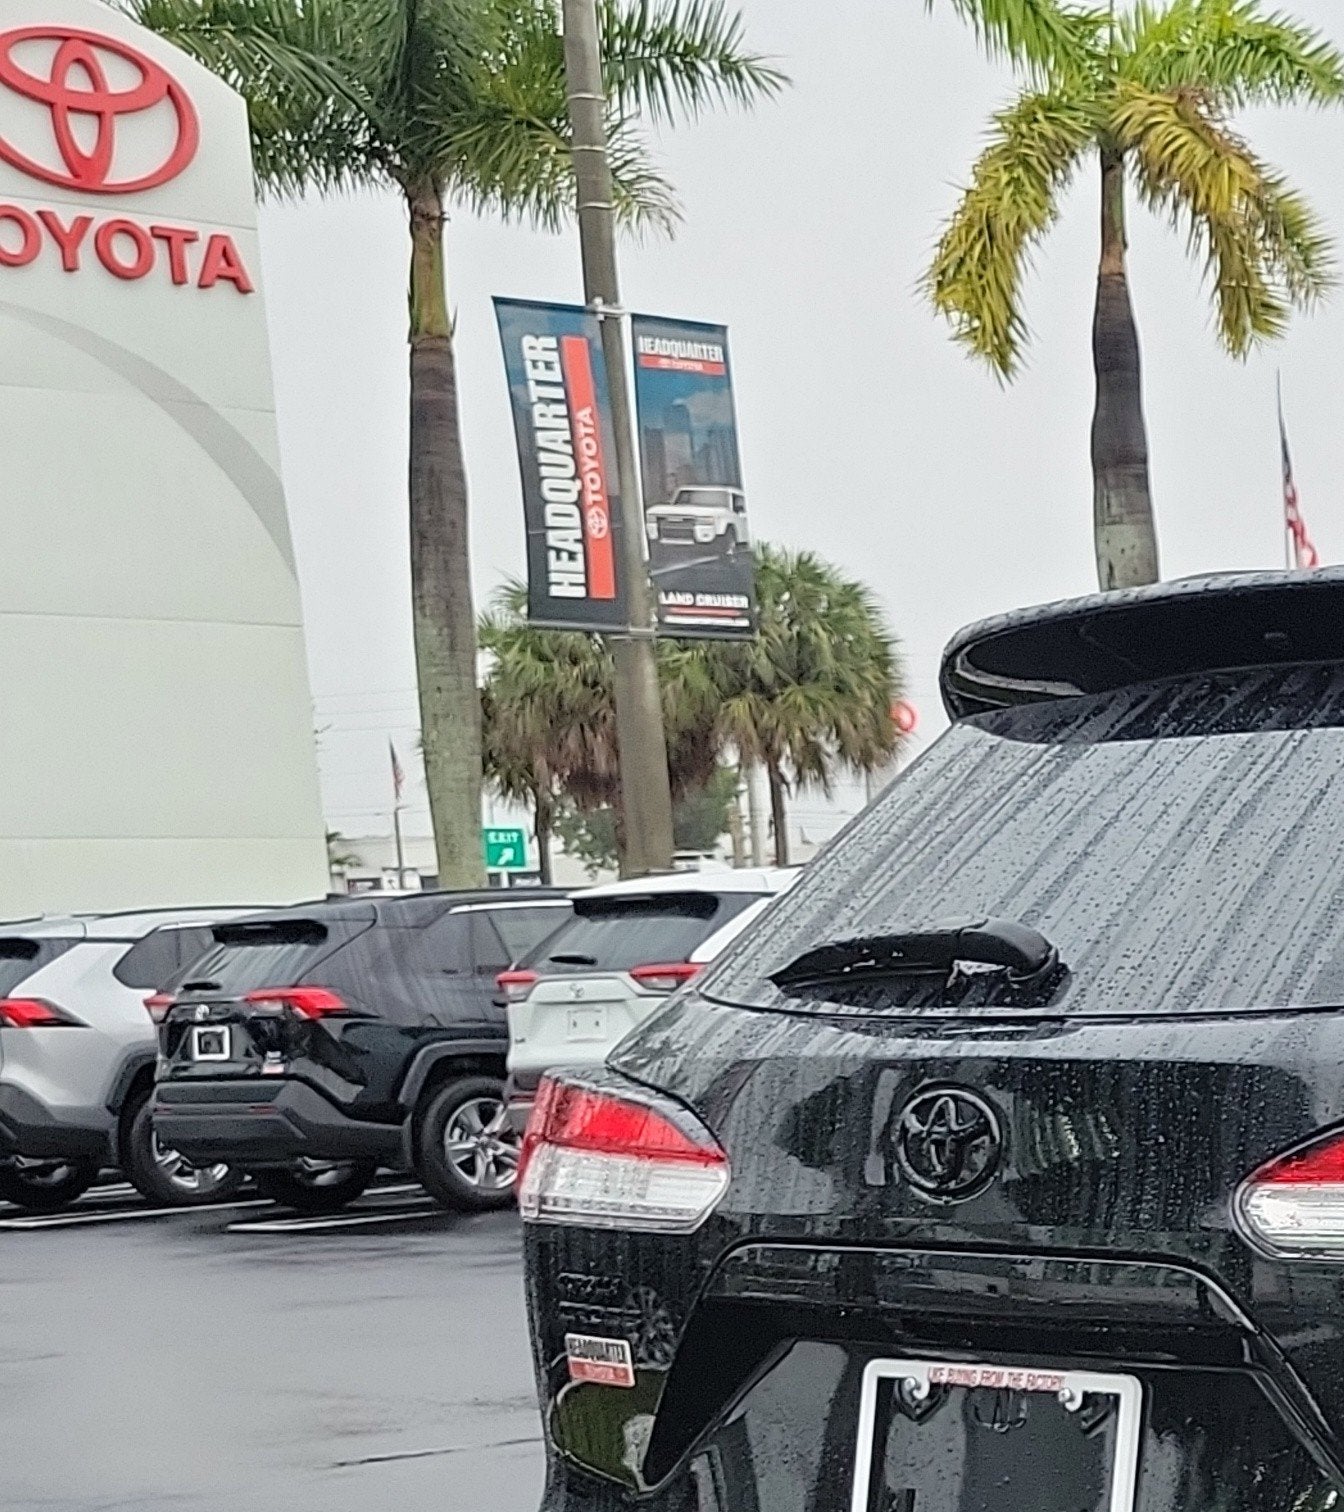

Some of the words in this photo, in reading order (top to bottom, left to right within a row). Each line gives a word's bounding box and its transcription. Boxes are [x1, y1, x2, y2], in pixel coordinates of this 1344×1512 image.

[521, 334, 587, 598] HEADQUARTER
[574, 405, 605, 505] TOYOTA
[659, 591, 694, 606] LAND
[695, 593, 749, 609] CRUISER
[487, 831, 518, 844] EXIT
